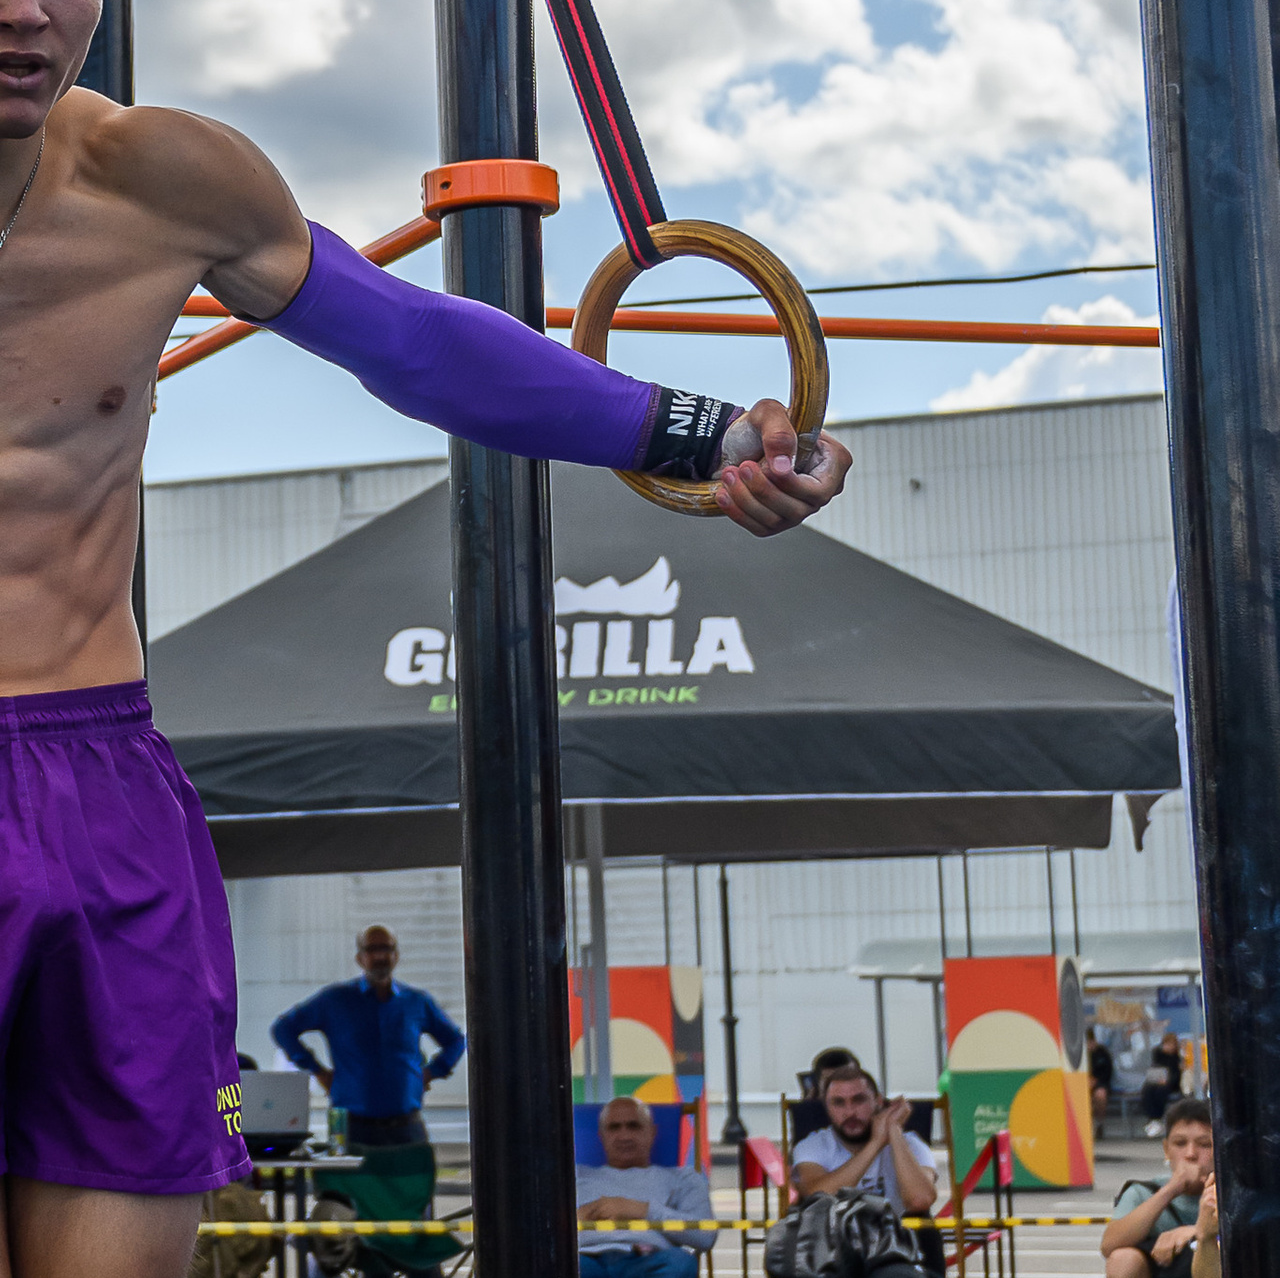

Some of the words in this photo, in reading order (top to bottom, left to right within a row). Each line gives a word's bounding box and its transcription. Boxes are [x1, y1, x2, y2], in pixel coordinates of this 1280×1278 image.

[696, 410, 710, 437] WHAT
[384, 616, 754, 686] GILLA
[587, 685, 700, 707] DRINK
